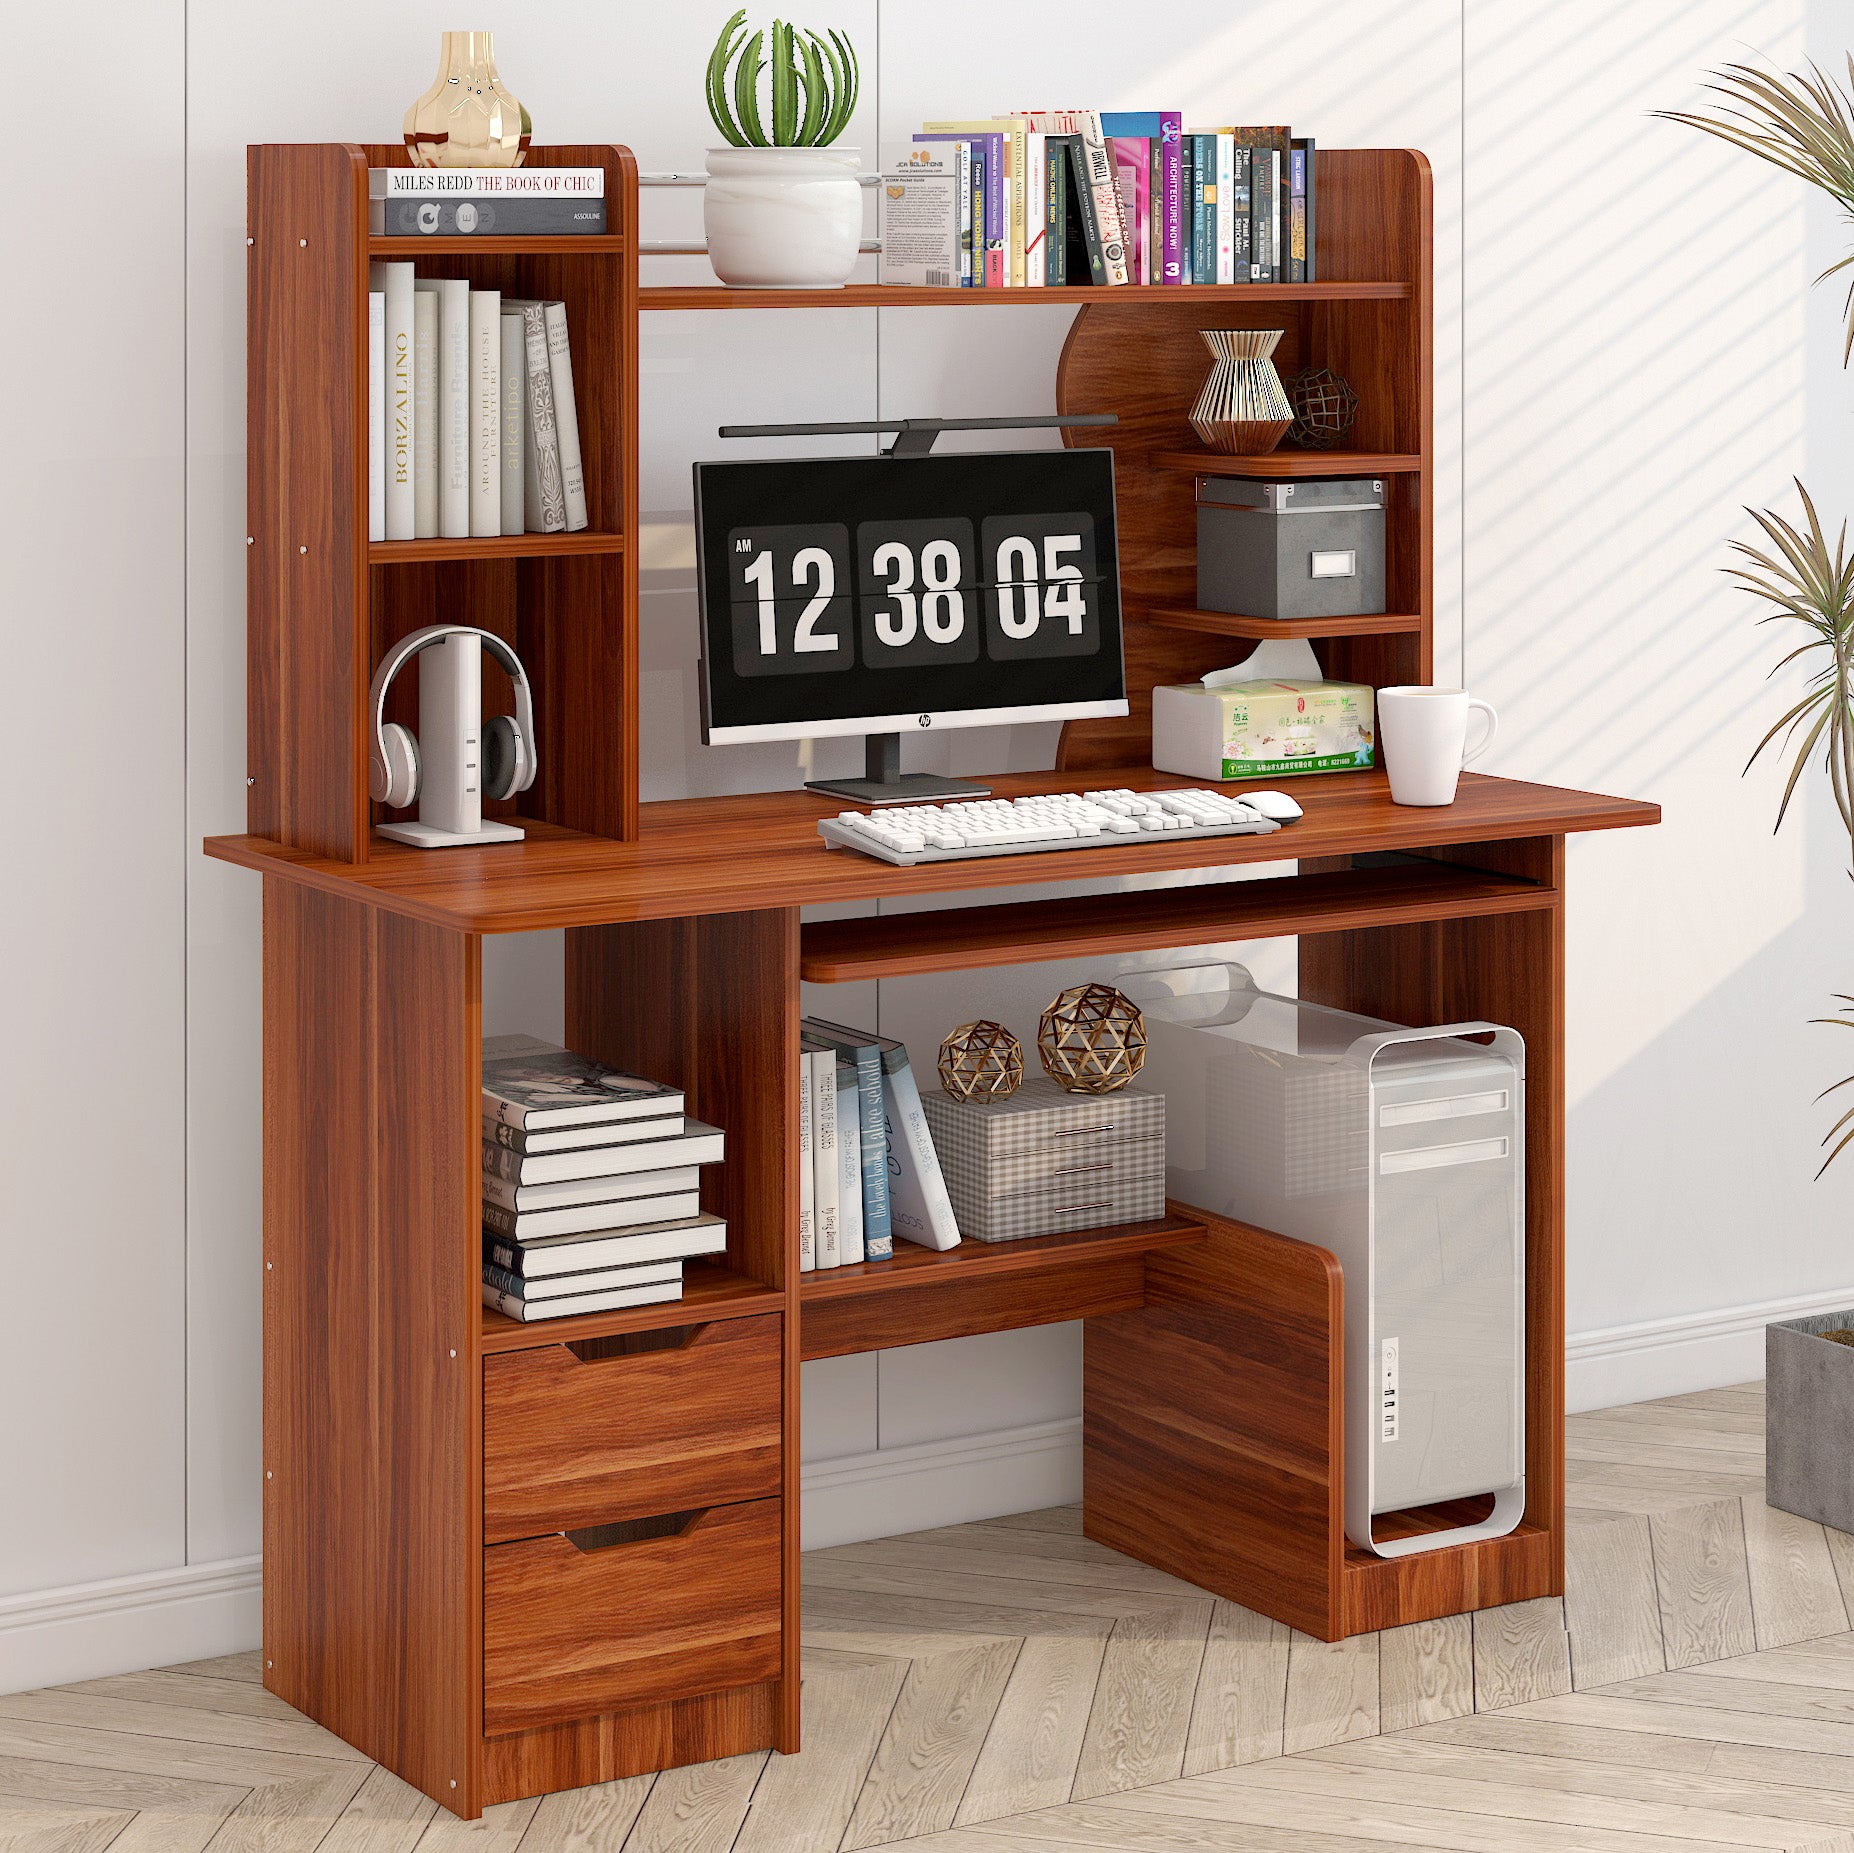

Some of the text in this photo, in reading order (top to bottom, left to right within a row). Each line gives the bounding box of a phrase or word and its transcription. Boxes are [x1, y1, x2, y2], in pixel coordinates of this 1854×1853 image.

[394, 176, 472, 190] MILES REDD
[476, 177, 502, 190] THE
[506, 177, 541, 190] BOOK
[545, 177, 561, 190] OF
[565, 177, 594, 190] CHIC
[963, 176, 968, 184] AT
[1092, 151, 1107, 179] ORWELL
[1196, 170, 1203, 182] ON
[1234, 149, 1242, 180] Calling
[1262, 157, 1271, 197] VAMPIRE
[1220, 186, 1230, 241] Slow Love
[1243, 239, 1249, 250] M.
[974, 249, 982, 285] NIGHTS
[416, 329, 429, 405] Harris
[396, 332, 407, 484] BORZALINO
[451, 320, 462, 489] Furniture Brands
[504, 376, 521, 470] arketipo
[735, 539, 752, 553] AM
[744, 547, 839, 656] 12
[872, 539, 965, 648] 38
[919, 714, 931, 728] hp
[820, 1073, 833, 1150] THREE PAIRS OF GLASSES
[857, 1058, 885, 1140] alice sebold
[867, 1150, 888, 1218] the lovely bones
[821, 1207, 835, 1251] by Greg Bennet
